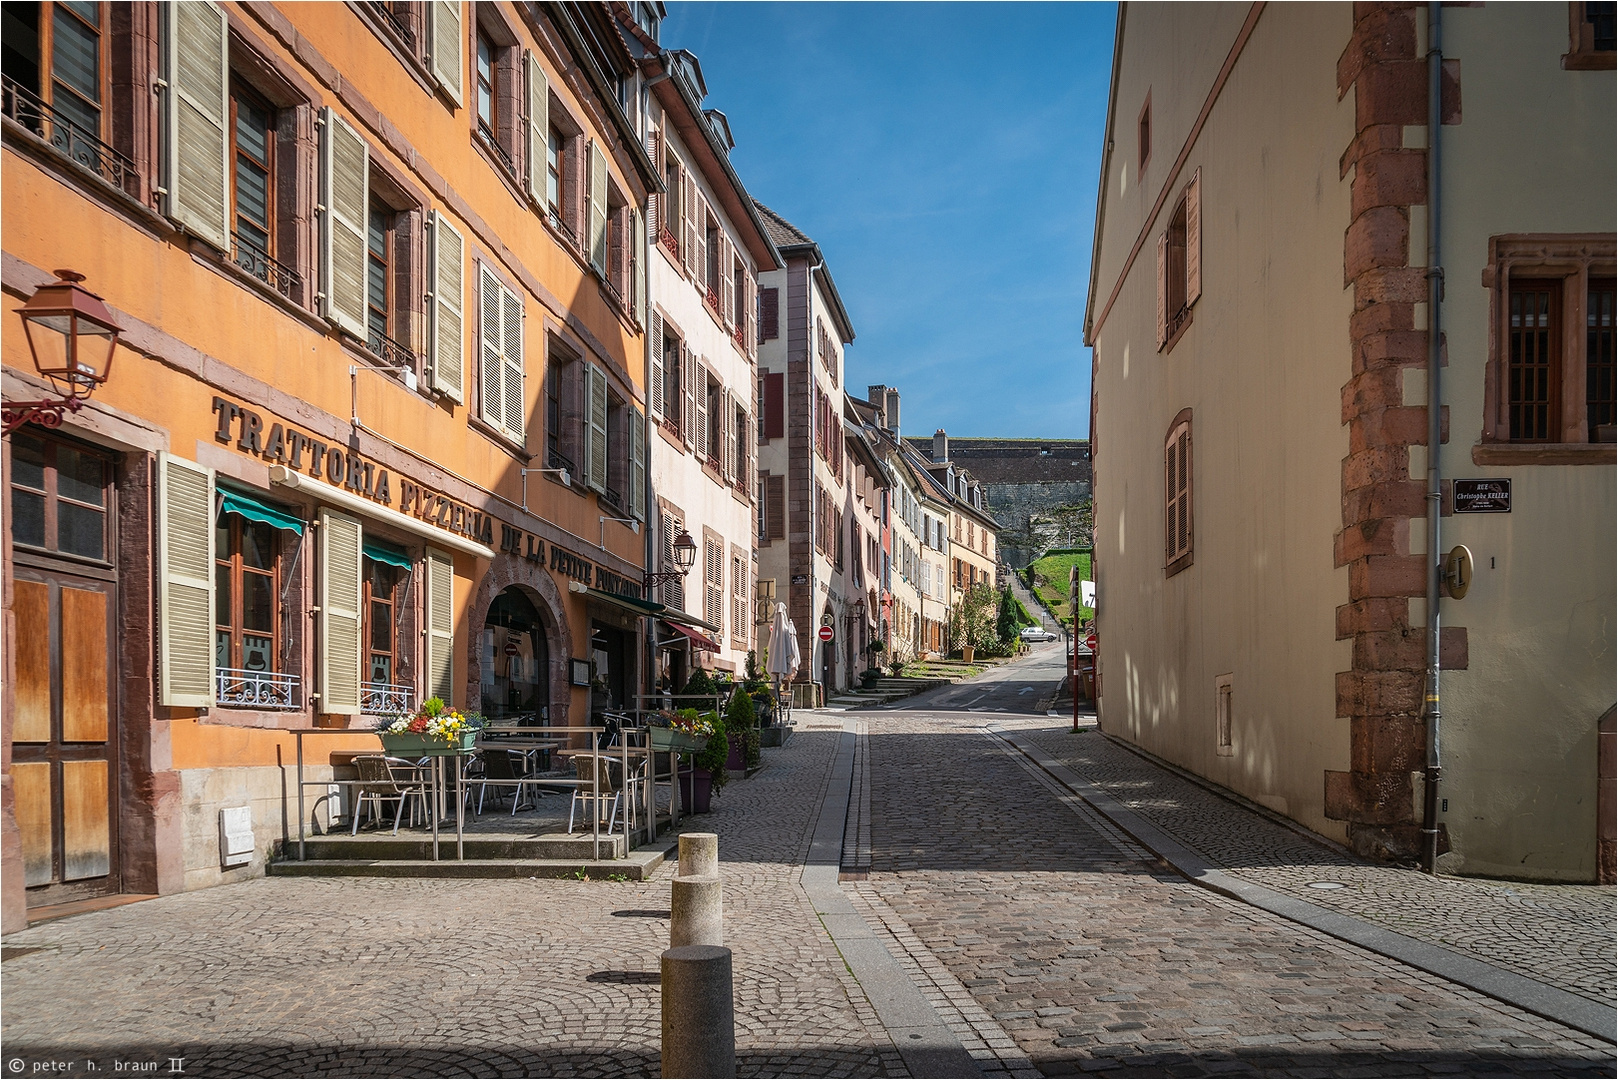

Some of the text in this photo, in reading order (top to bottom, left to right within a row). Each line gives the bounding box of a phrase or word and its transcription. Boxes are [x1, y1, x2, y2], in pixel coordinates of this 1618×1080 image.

[212, 396, 392, 505] TRATTORIA
[400, 478, 494, 545] PIZZERIA
[501, 523, 523, 555] DE
[526, 535, 548, 566] LA
[550, 545, 593, 585] PETITE
[1476, 483, 1489, 491] RUE
[1456, 492, 1487, 501] Christophe
